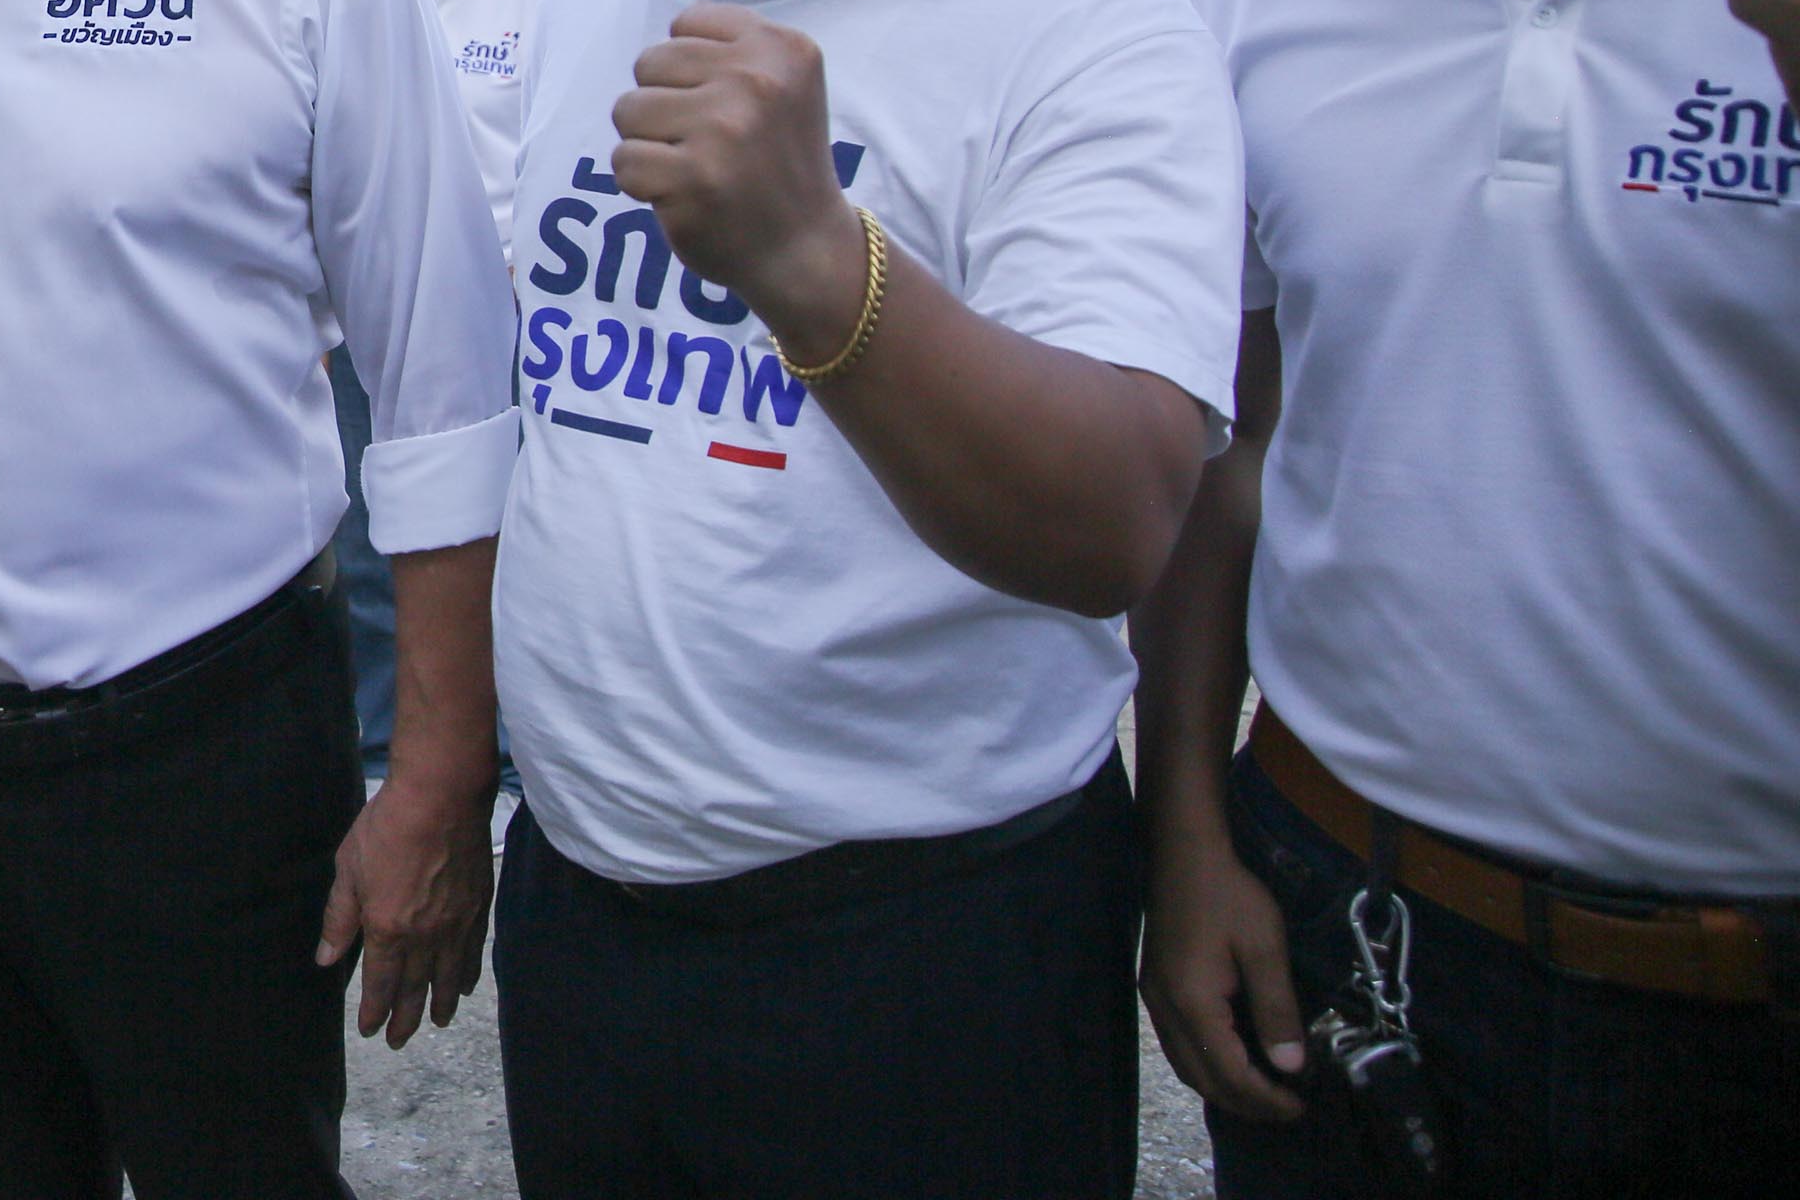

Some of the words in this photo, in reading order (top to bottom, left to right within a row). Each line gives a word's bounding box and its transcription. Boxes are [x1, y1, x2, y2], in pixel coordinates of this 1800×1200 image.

[462, 40, 512, 61] รักษ์
[1668, 78, 1800, 152] รัก
[521, 306, 808, 428] รุงเทพ
